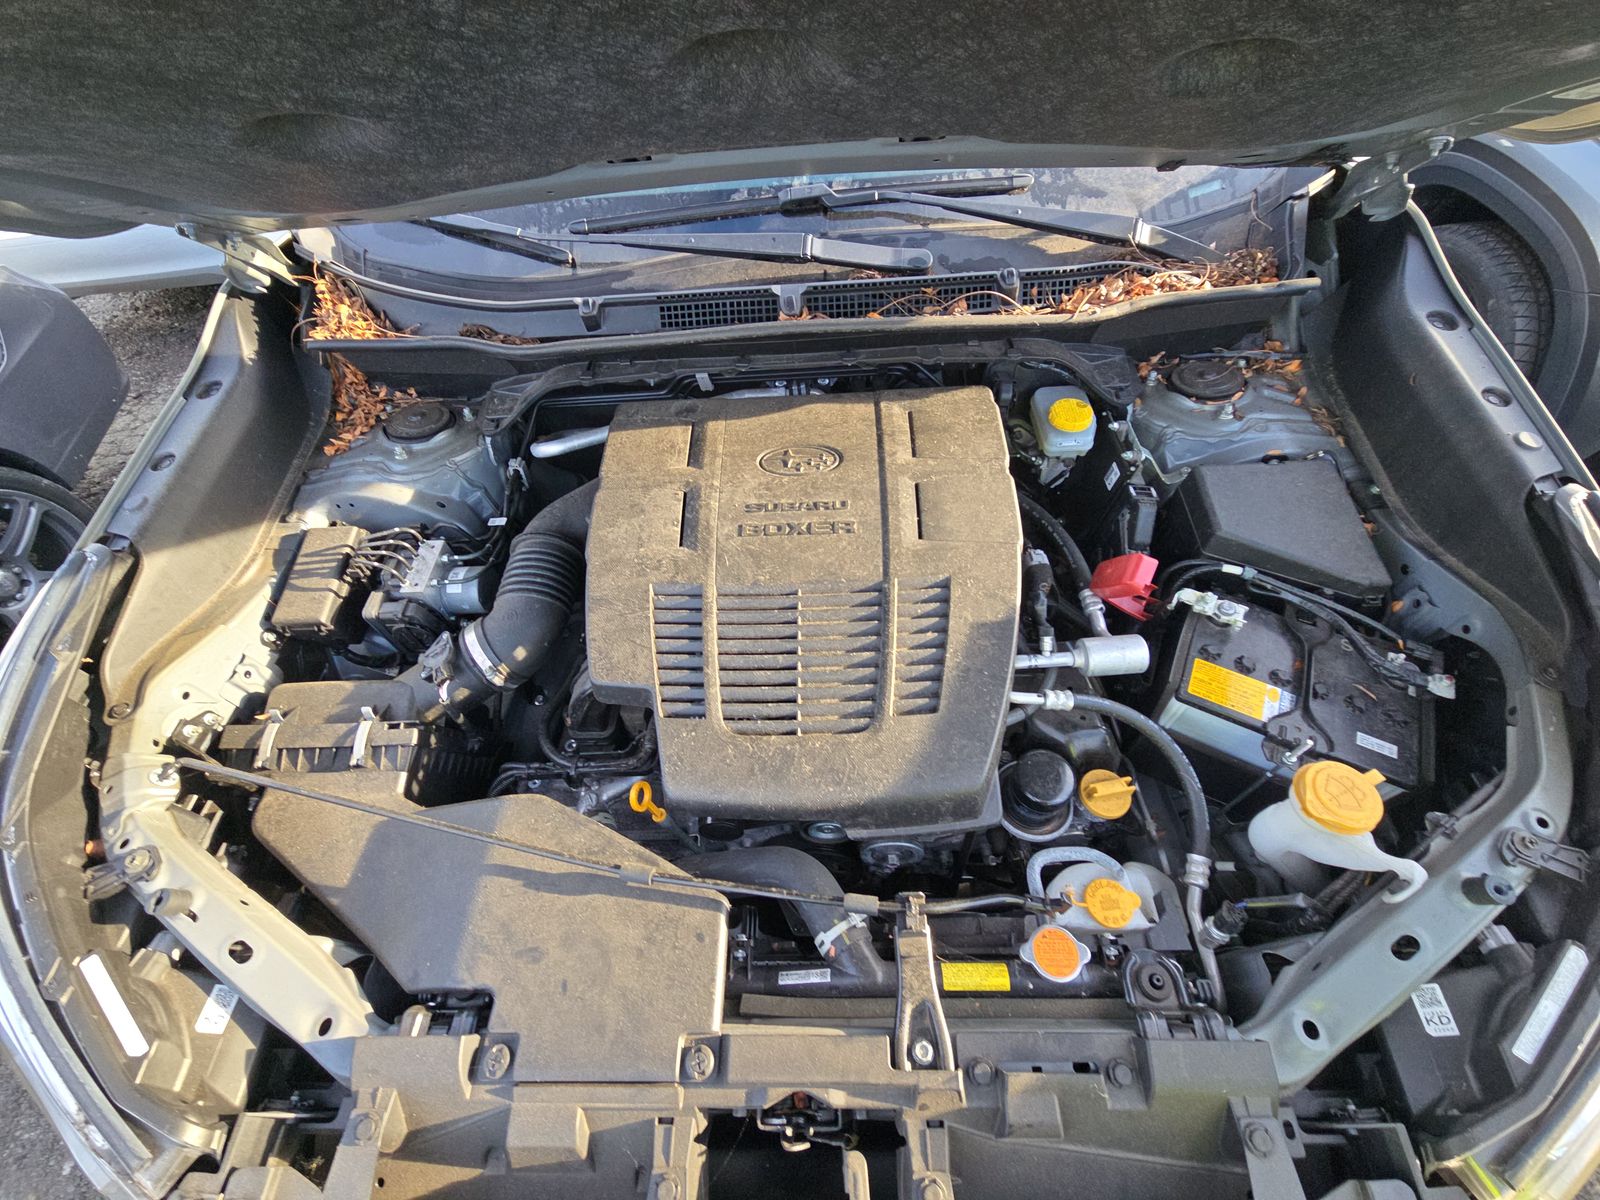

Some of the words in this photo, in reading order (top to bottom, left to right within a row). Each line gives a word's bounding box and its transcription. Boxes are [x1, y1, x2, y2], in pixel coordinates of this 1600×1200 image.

[744, 500, 849, 513] SUBARU
[737, 521, 857, 537] BOXER
[1424, 1015, 1451, 1026] KD
